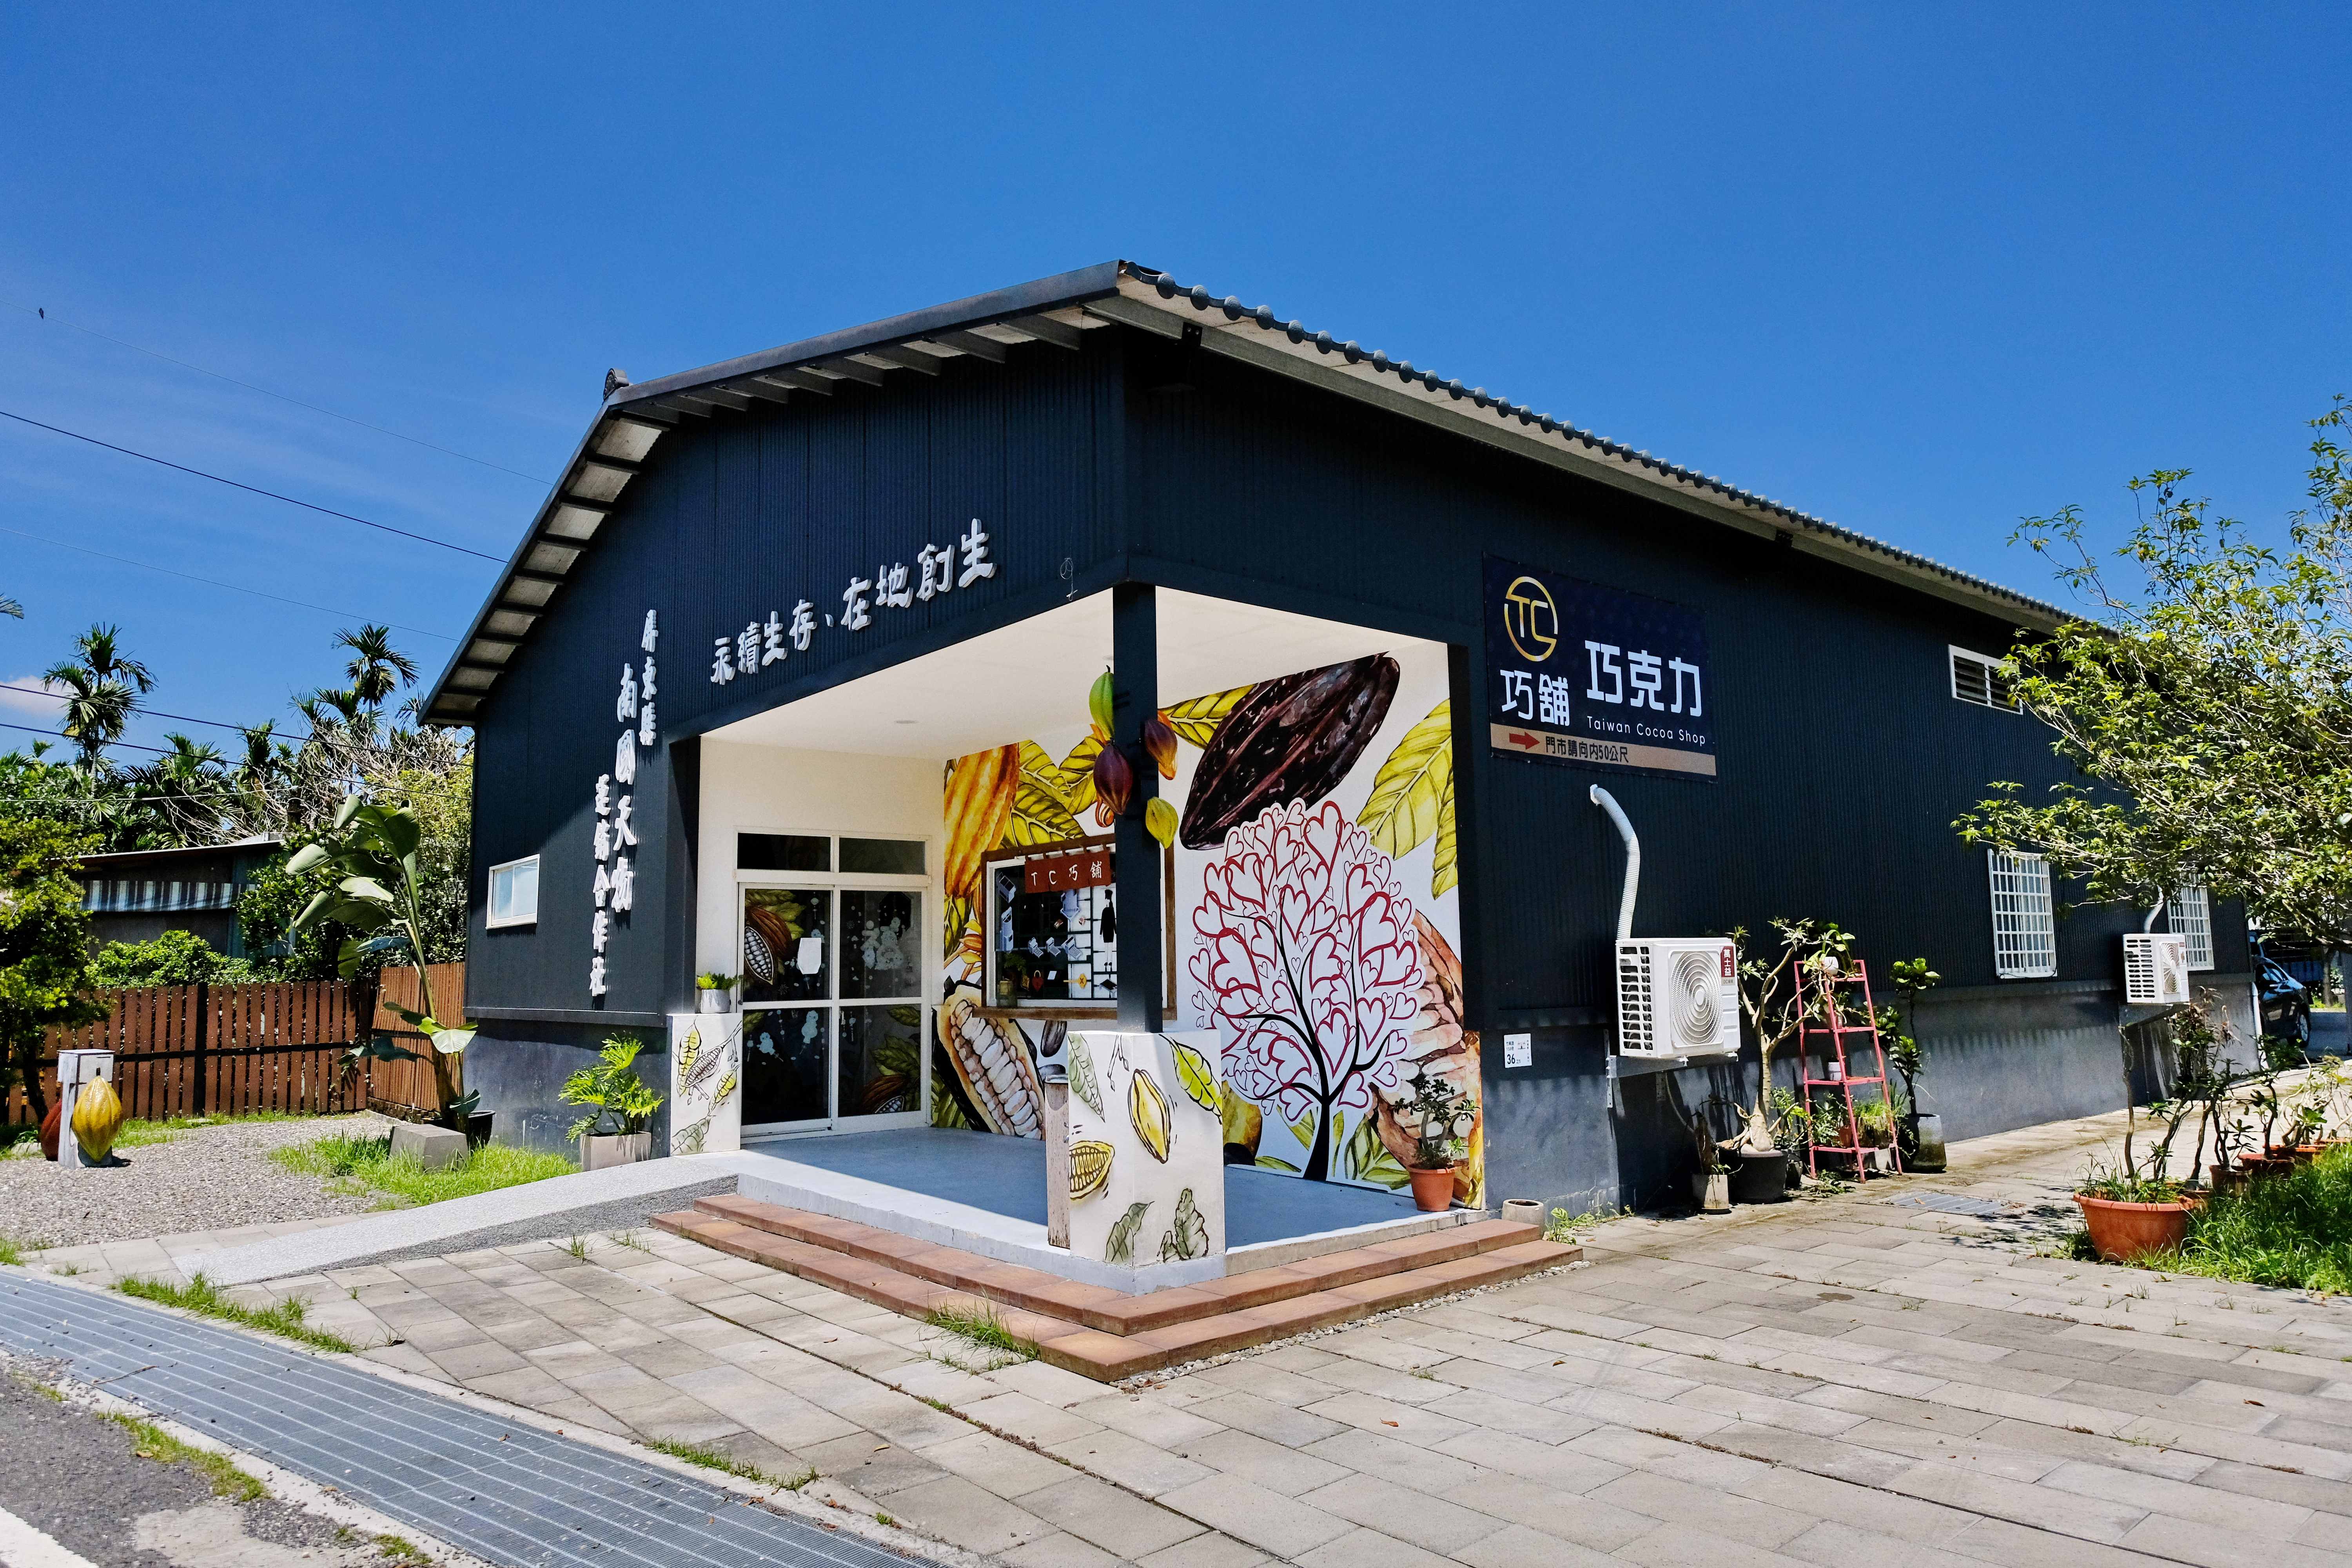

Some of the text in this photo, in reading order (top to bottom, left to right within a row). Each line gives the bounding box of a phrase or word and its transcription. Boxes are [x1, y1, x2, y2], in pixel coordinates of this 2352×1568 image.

[710, 518, 997, 685] 永續生存、在地創生
[1504, 576, 1558, 662] TC
[639, 609, 659, 746] 屏東縣
[1500, 670, 1570, 726] 巧舖
[1585, 640, 1702, 717] 巧克力
[1587, 716, 1706, 747] Taiwan Cocoa Shop
[1723, 949, 1731, 976] 萬士益
